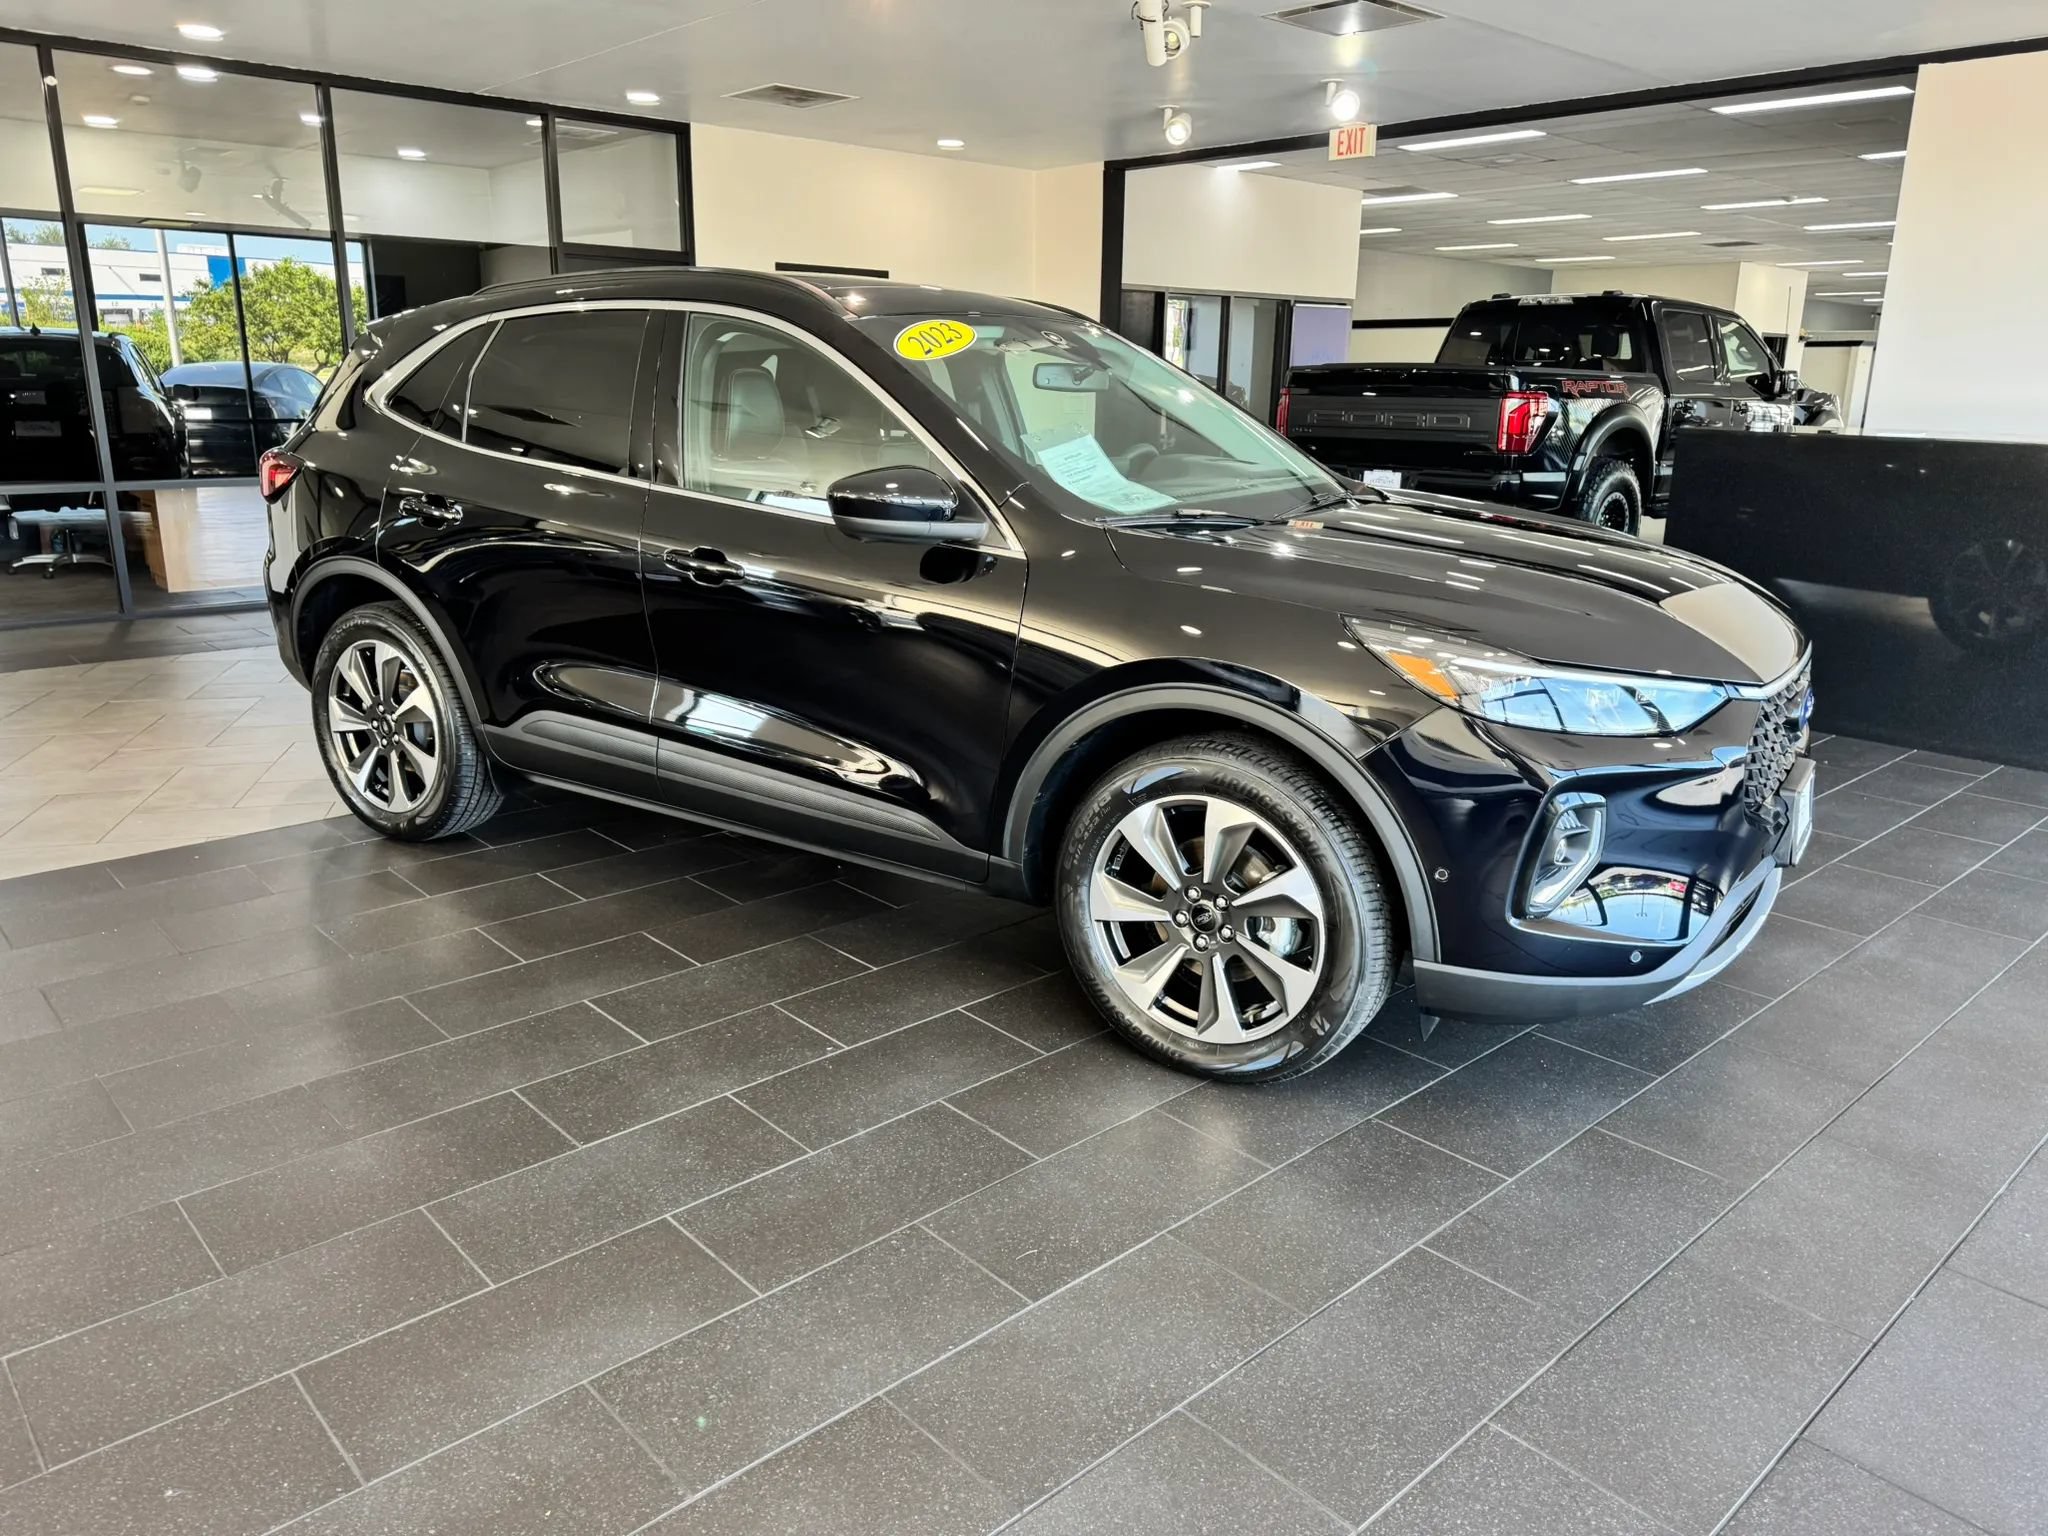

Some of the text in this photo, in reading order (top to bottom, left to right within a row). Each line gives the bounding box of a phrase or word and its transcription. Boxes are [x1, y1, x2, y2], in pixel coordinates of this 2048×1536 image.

[1337, 127, 1366, 156] EXIT
[908, 322, 962, 355] 2023
[1561, 380, 1631, 400] RAPTOR
[1307, 410, 1471, 429] FORD
[1212, 772, 1328, 864] BRIDGESTONE
